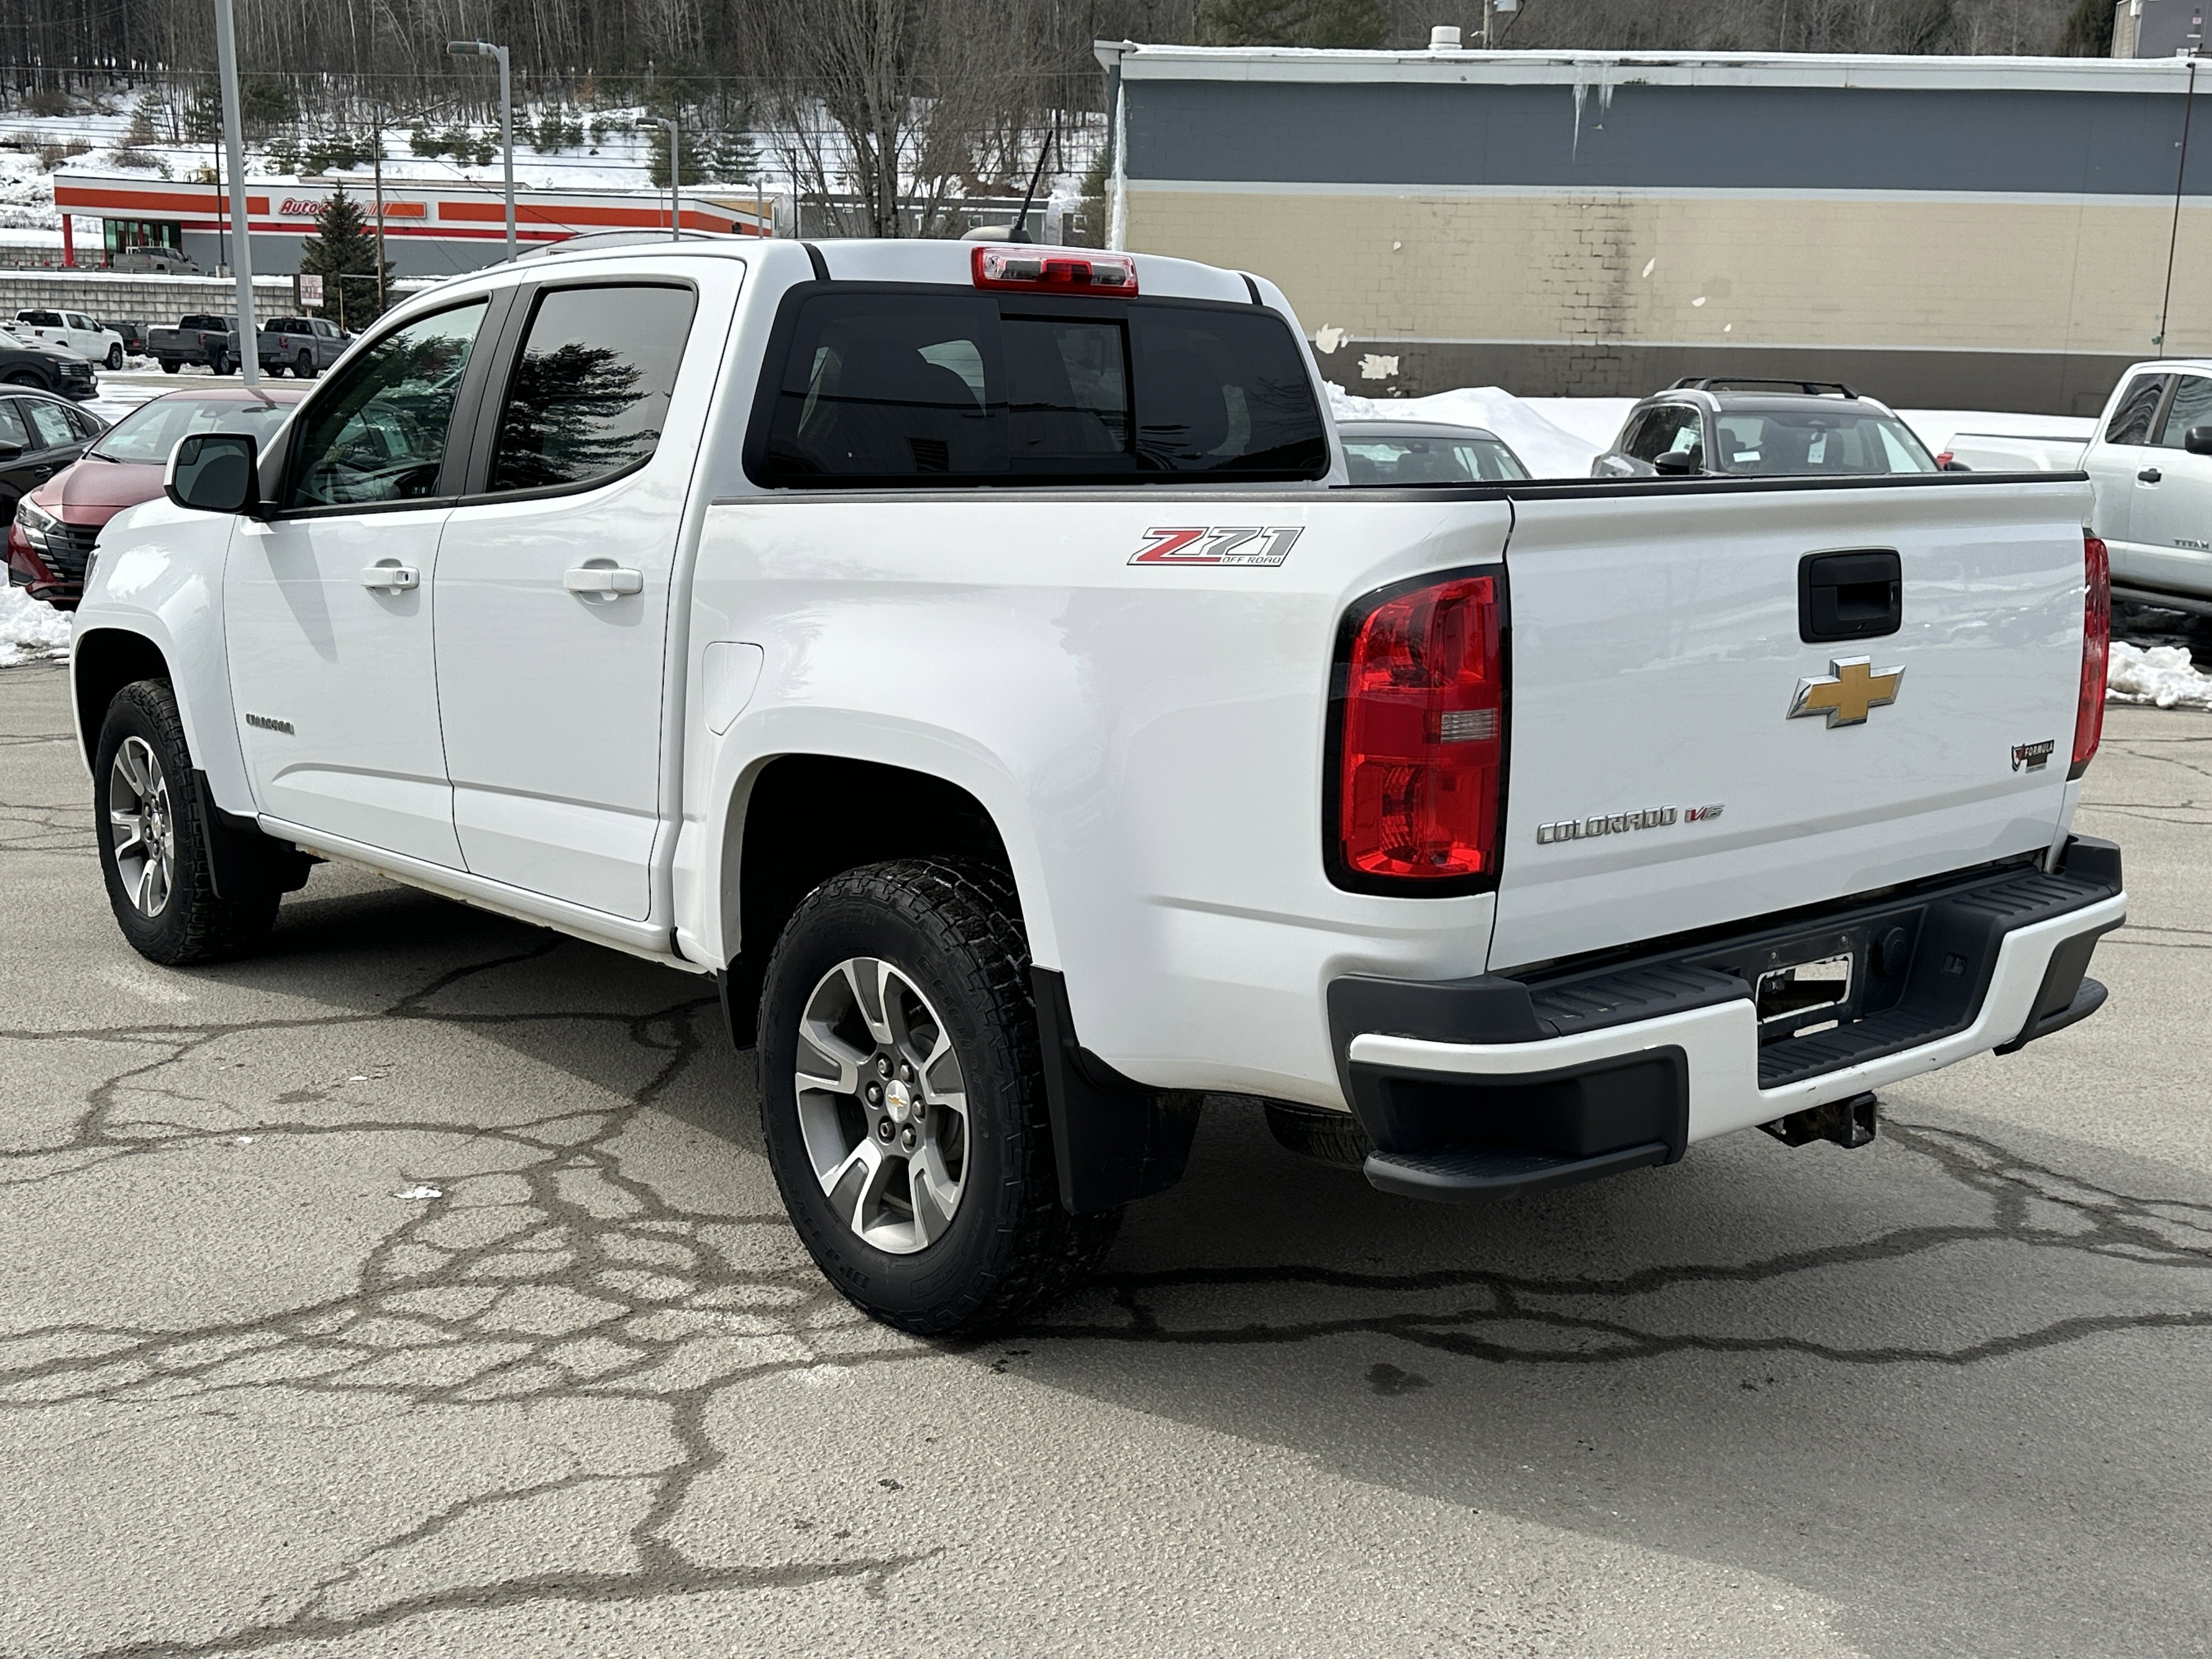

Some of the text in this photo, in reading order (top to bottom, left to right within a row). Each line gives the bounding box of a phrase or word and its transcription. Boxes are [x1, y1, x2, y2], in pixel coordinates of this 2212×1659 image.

[1127, 527, 1305, 567] Z71
[2174, 539, 2209, 549] TITAN
[1537, 803, 1725, 844] COLORADO V6
